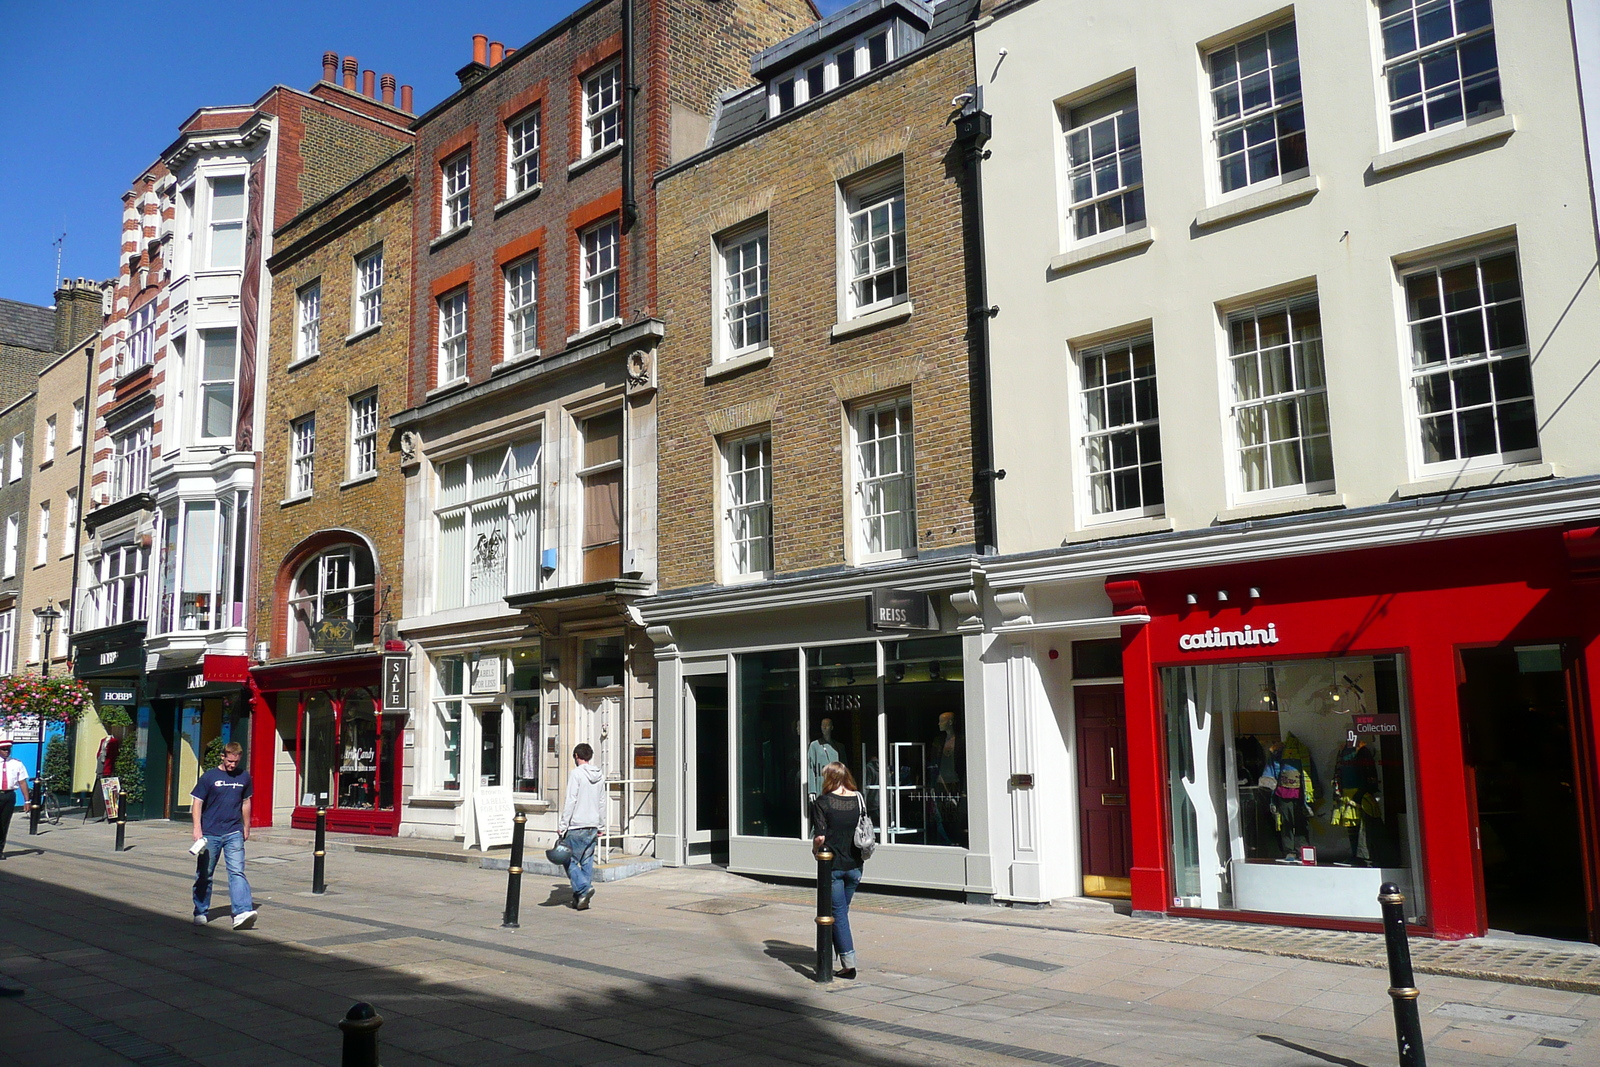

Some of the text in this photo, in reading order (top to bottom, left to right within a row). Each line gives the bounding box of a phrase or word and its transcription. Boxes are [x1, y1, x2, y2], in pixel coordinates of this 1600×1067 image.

[880, 607, 907, 622] REISS
[1179, 622, 1279, 650] catimini
[391, 662, 401, 705] SALE
[825, 694, 861, 711] REISS
[1356, 723, 1398, 733] Collection
